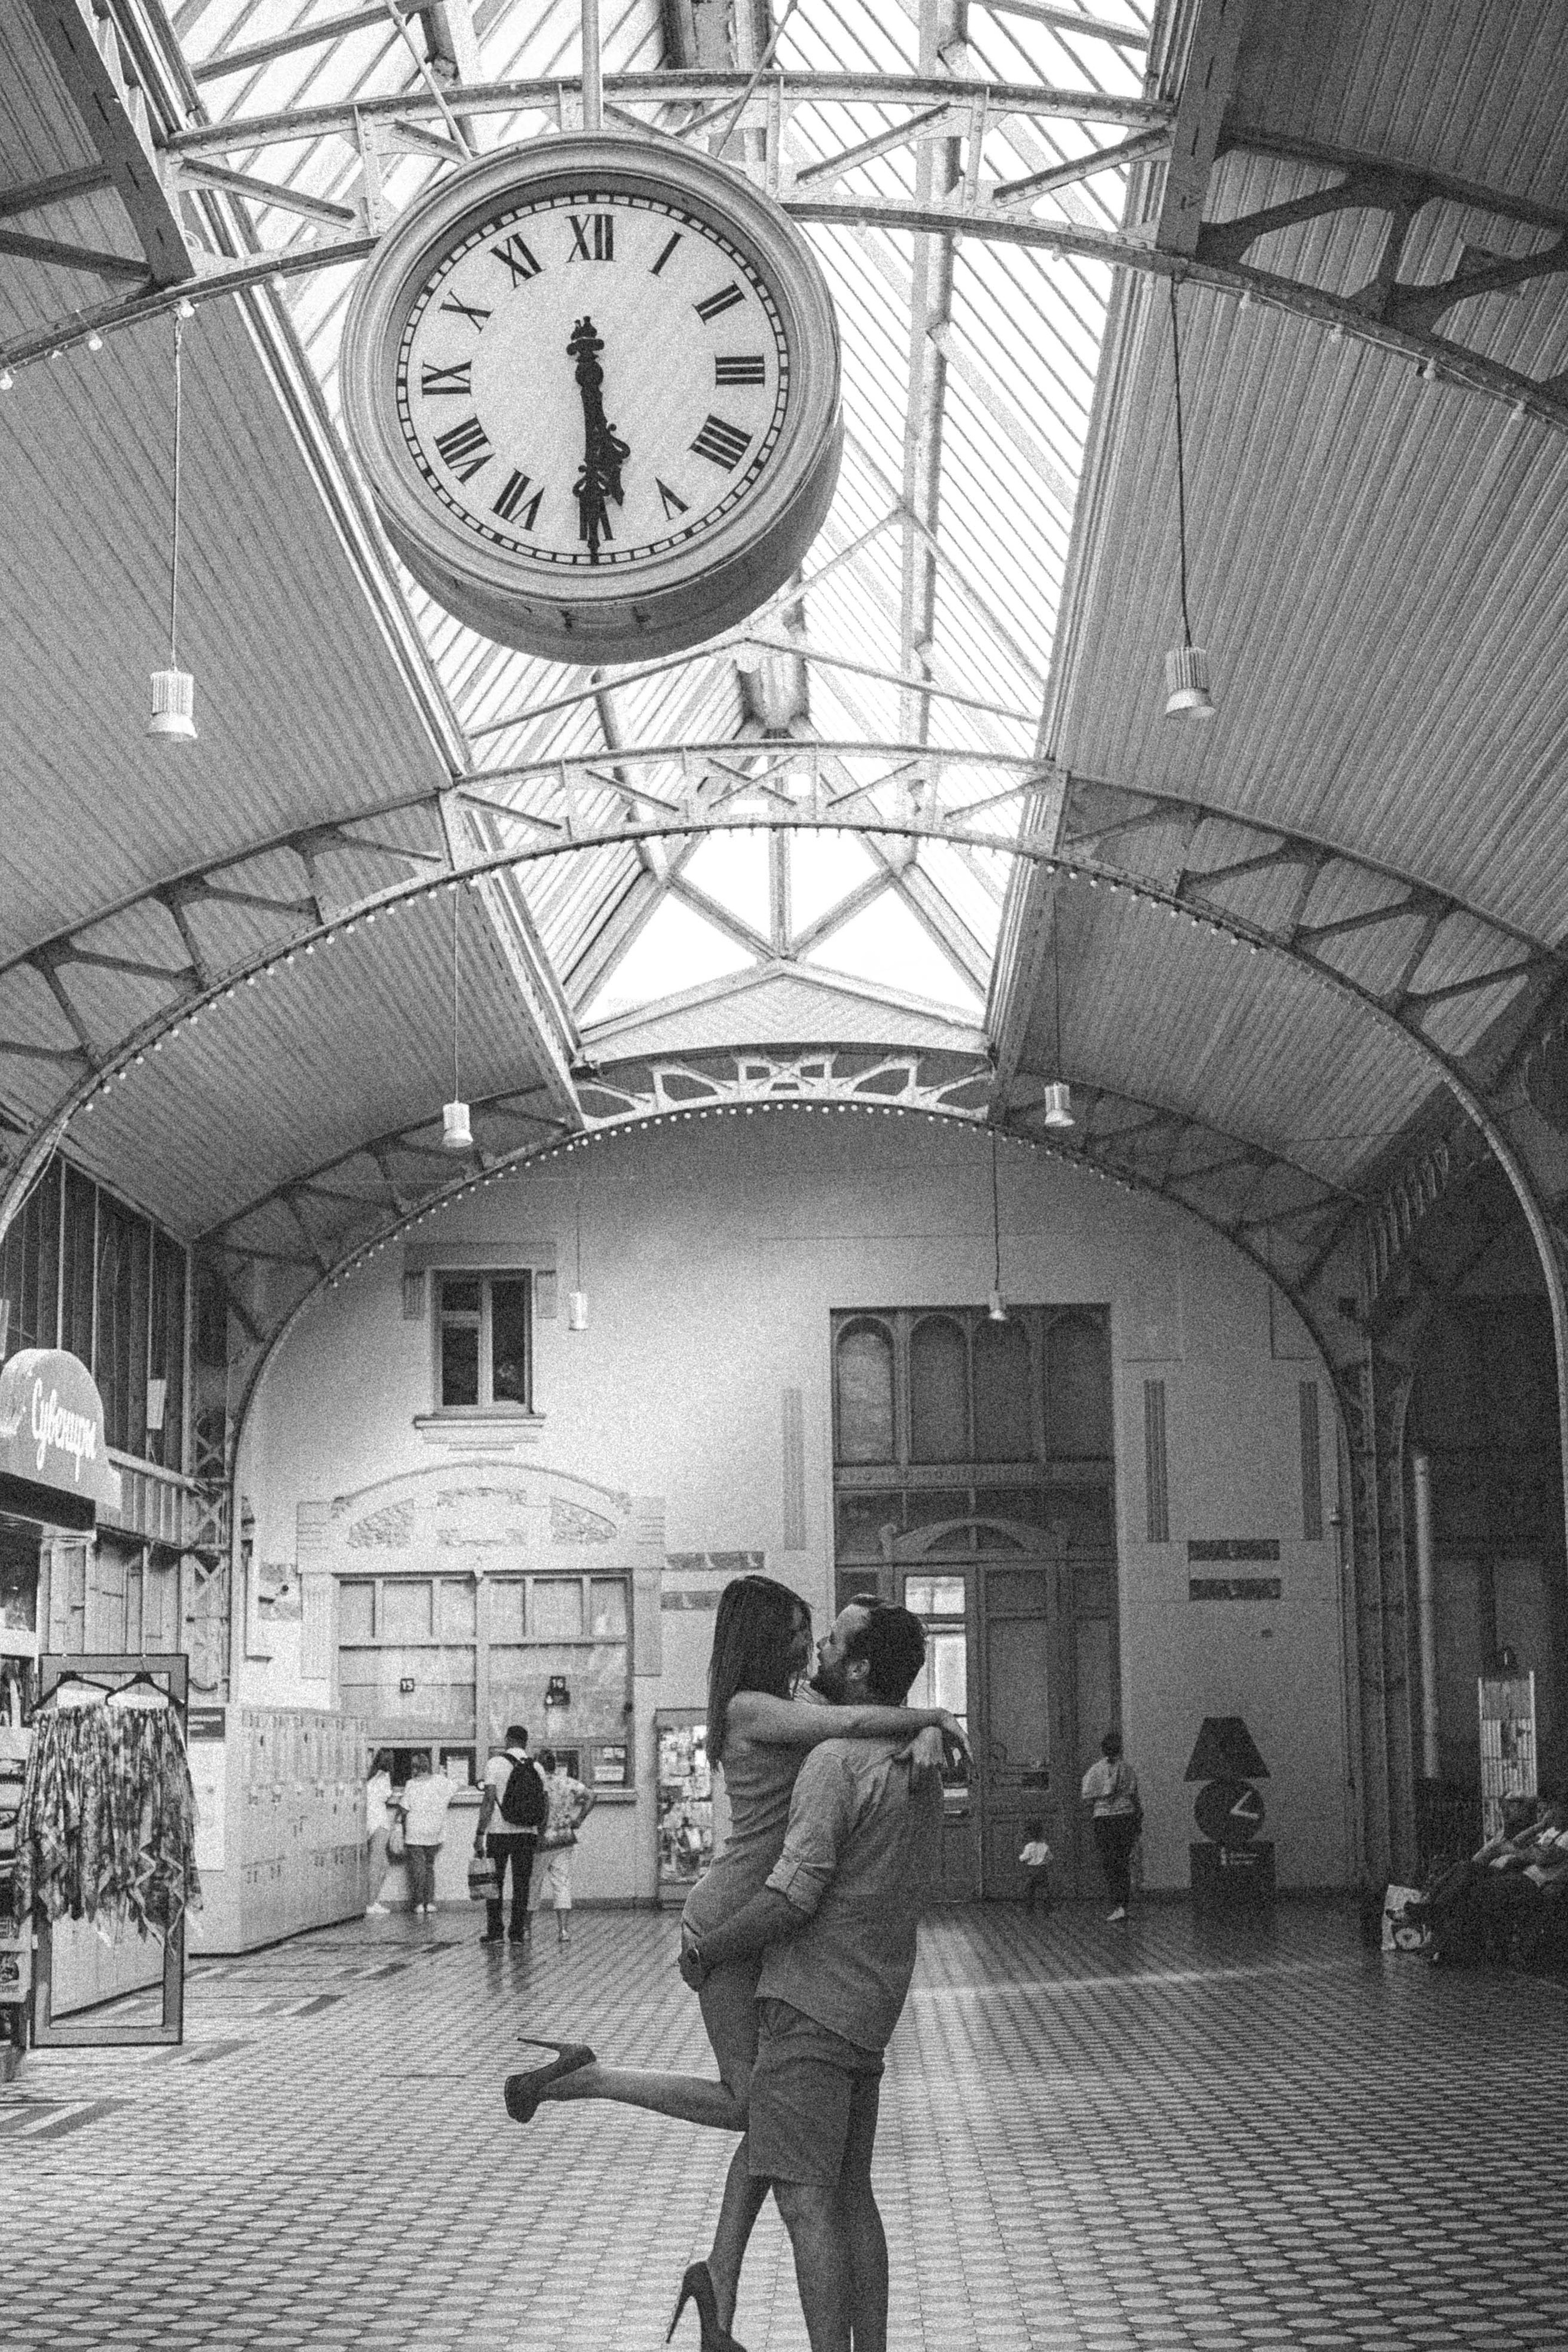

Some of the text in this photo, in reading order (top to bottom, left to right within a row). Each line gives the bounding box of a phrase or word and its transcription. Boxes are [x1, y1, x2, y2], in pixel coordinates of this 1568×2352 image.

[565, 214, 617, 262] XII
[649, 230, 685, 277] I
[488, 232, 546, 291] XI
[438, 288, 493, 334] X
[692, 280, 747, 325] II
[421, 360, 472, 398] IX
[714, 353, 765, 388] III
[433, 413, 496, 487] VIII
[687, 413, 753, 474] IIII
[489, 469, 545, 532] VII
[655, 477, 690, 522] V
[402, 1680, 413, 1690] 15
